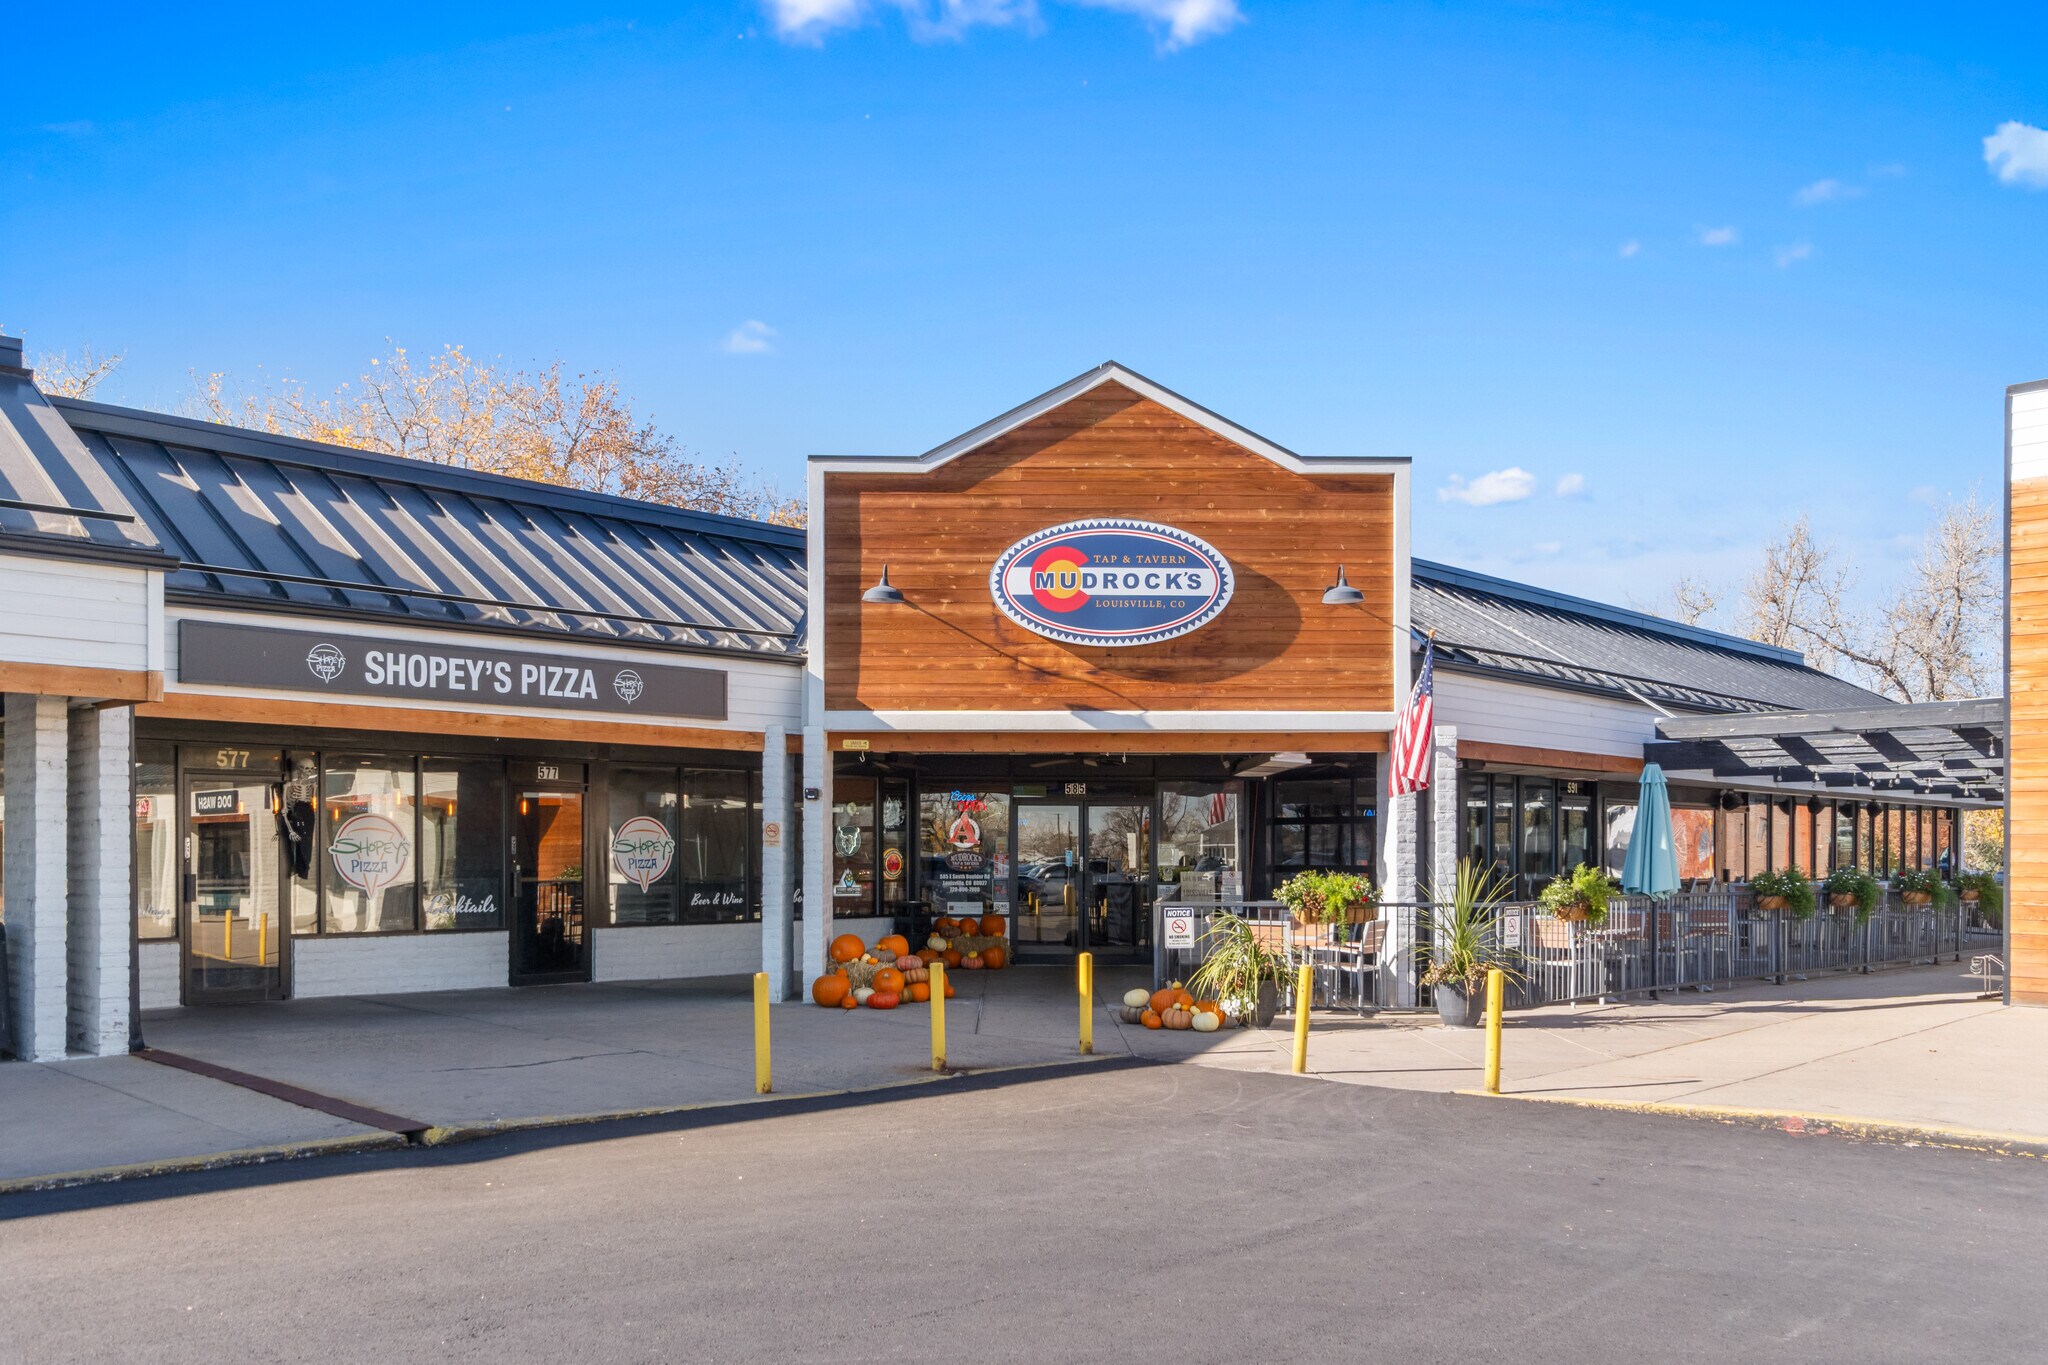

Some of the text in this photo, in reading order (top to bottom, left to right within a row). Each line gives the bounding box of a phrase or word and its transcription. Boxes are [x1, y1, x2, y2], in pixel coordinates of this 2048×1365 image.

[1093, 555, 1187, 564] TAP & TAVERN
[1035, 571, 1202, 590] MUDROCK'S
[1095, 600, 1186, 609] LOUISVILLE, CO
[316, 664, 336, 673] PIZZA
[365, 650, 598, 700] SHOPEY'S PIZZA
[216, 750, 250, 767] 577
[539, 767, 558, 779] 577
[1065, 783, 1086, 794] 585
[1567, 782, 1578, 794] 591
[950, 790, 976, 801] Coors
[957, 800, 987, 812] OPEN
[330, 836, 410, 864] SHOPEY'S
[351, 859, 388, 873] PIZZA
[628, 858, 658, 870] PIZZA
[690, 892, 744, 906] Beer & Wine
[1167, 909, 1191, 917] NOTICE
